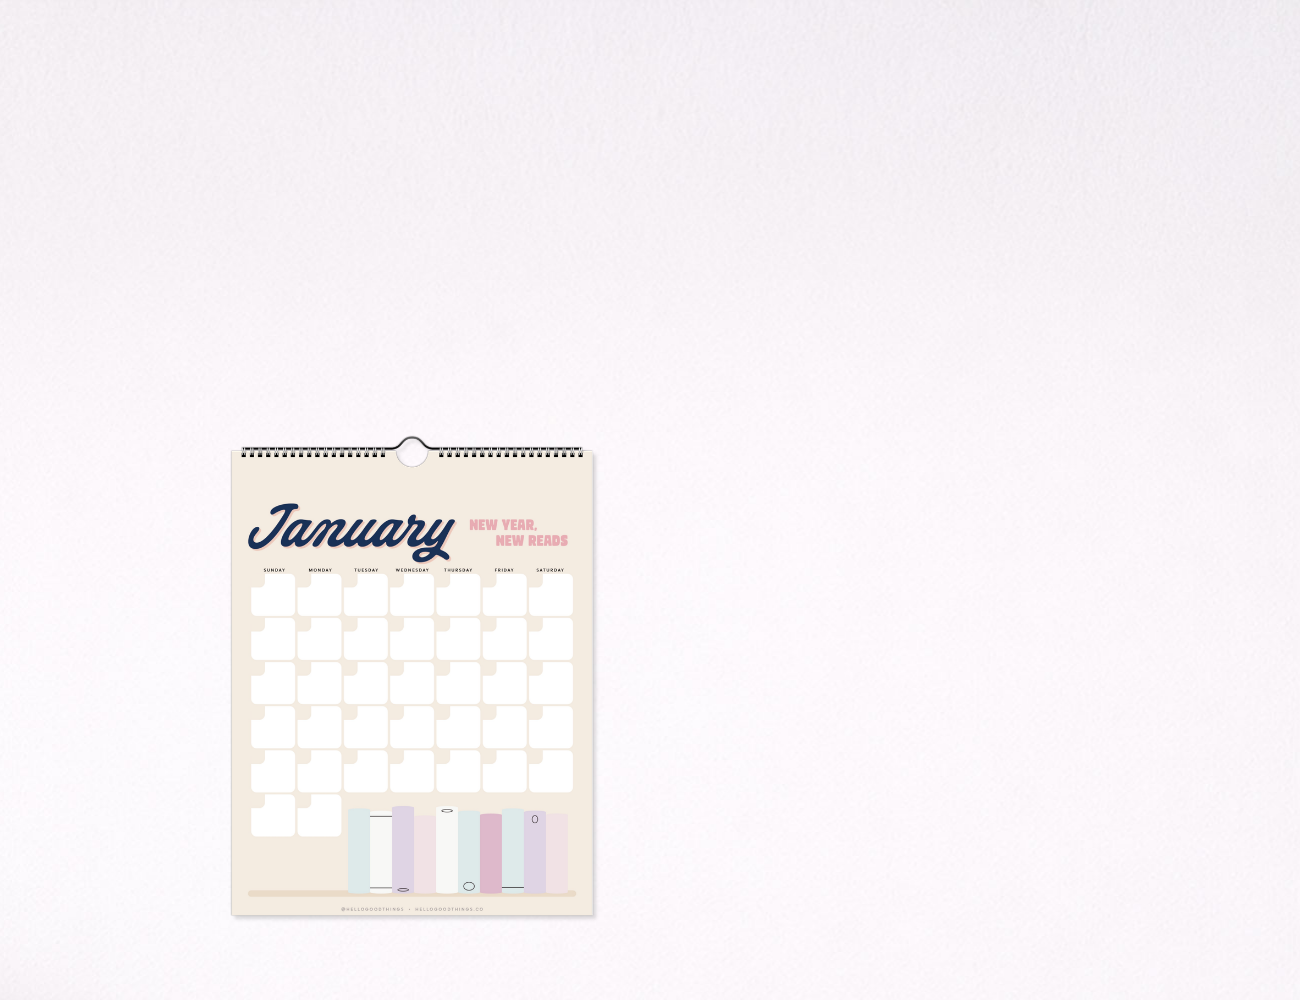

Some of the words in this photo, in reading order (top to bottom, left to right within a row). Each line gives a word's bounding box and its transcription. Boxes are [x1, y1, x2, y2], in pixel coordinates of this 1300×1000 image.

[470, 519, 498, 531] NEW
[502, 519, 538, 532] YEAR,
[248, 503, 456, 564] January
[496, 535, 524, 547] NEW
[528, 535, 568, 547] READS
